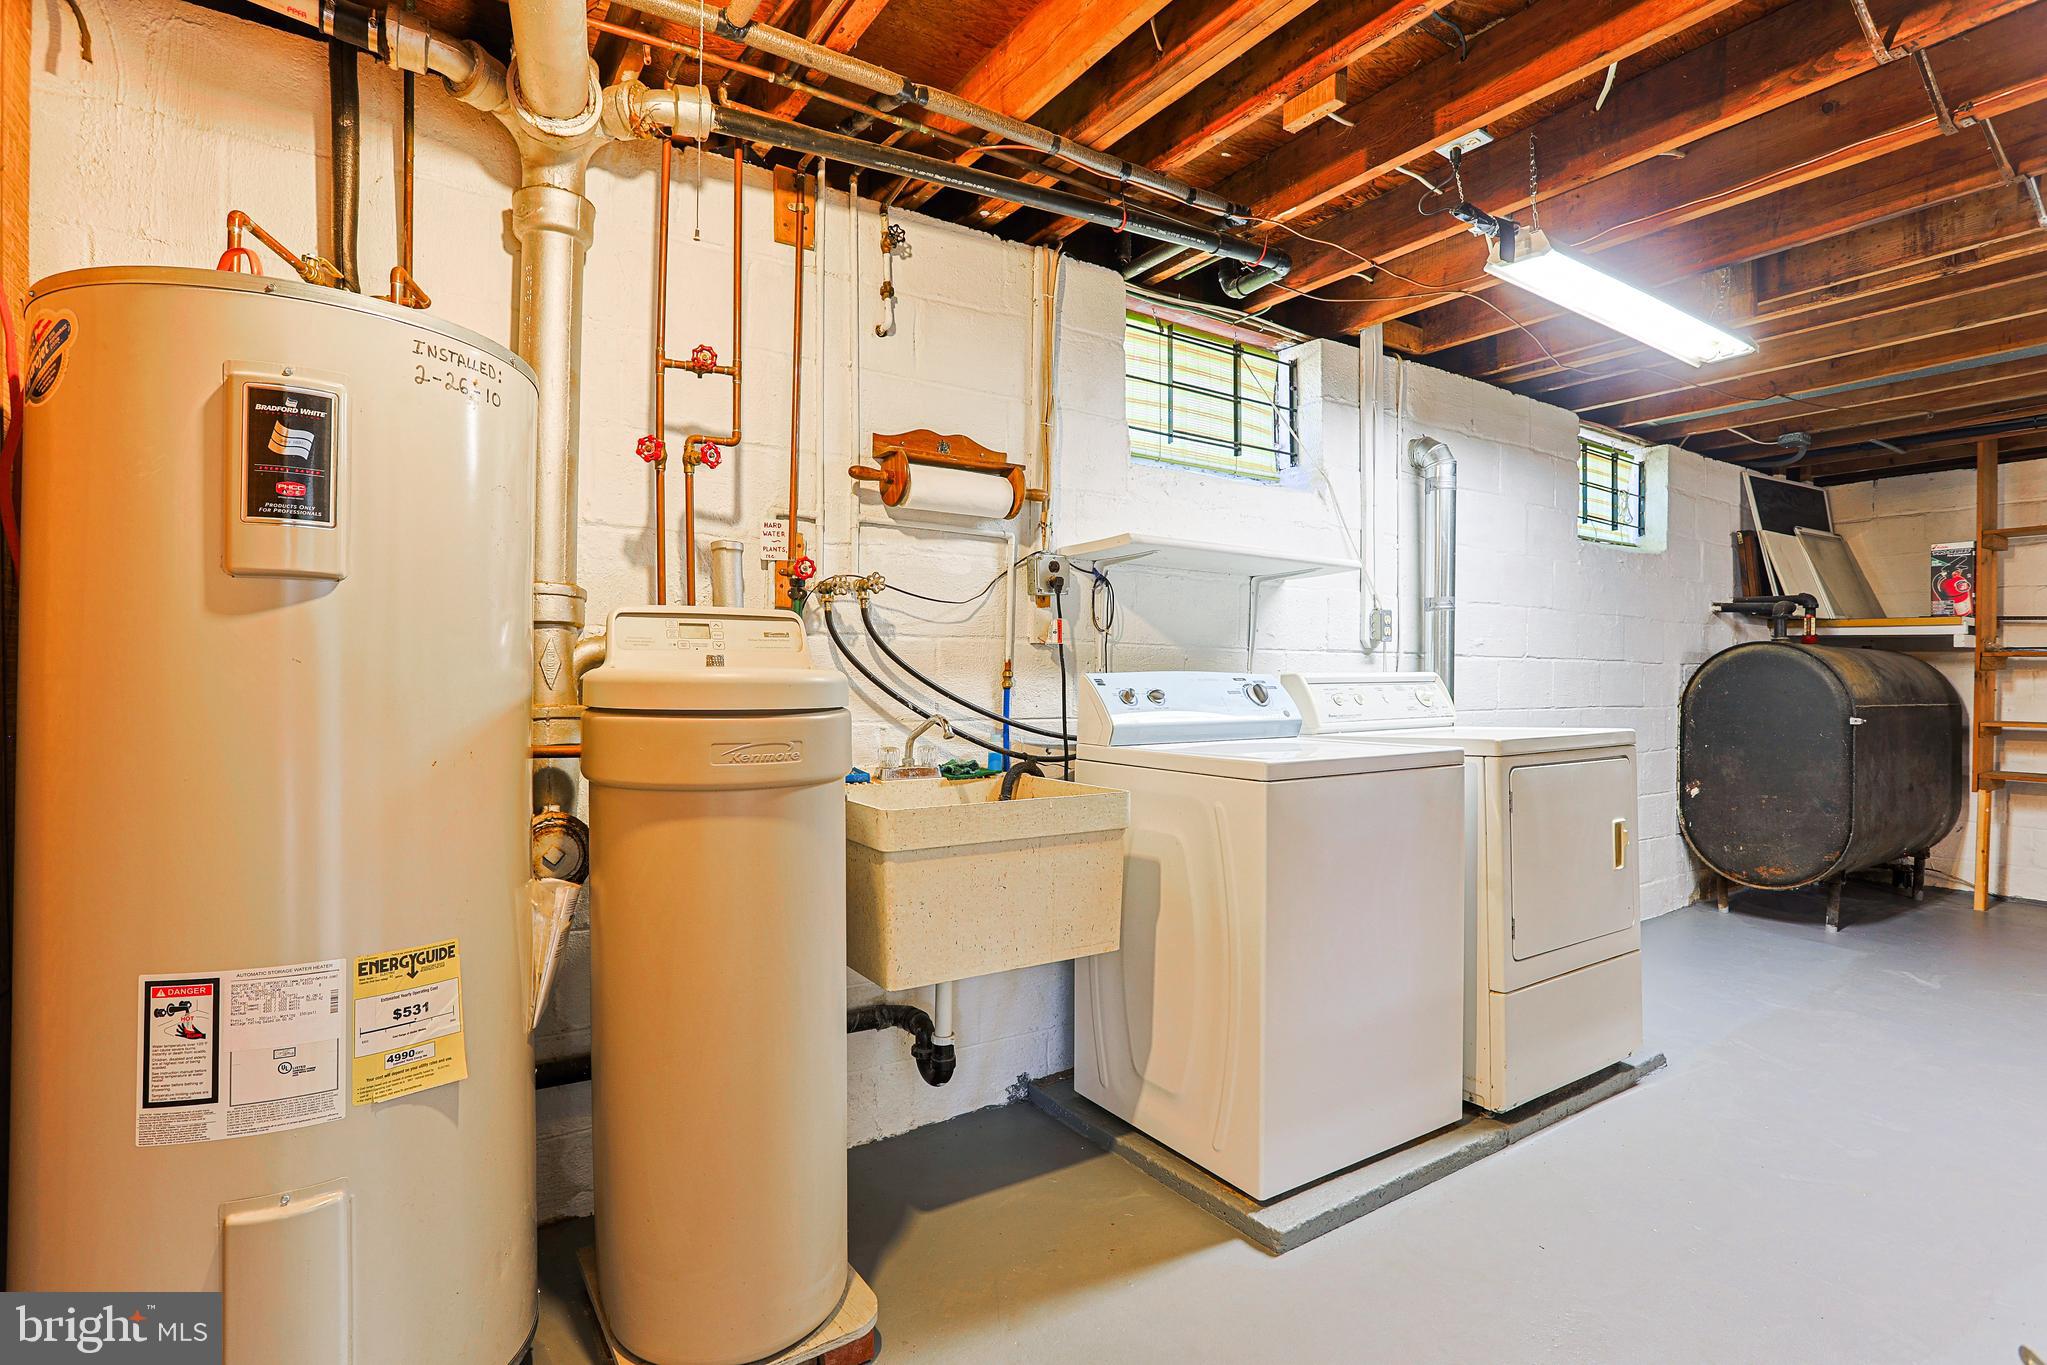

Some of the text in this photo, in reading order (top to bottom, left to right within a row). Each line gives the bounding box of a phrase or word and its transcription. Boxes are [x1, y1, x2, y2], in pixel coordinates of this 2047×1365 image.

[412, 339, 502, 384] INSTALLED:
[255, 403, 298, 414] BRADFORD
[300, 408, 326, 418] WHITE
[273, 508, 322, 517] PROFESSIONALS
[728, 750, 801, 764] Kenmore
[358, 945, 455, 978] ENERGYGUIDE
[167, 987, 206, 996] DANGER
[392, 1001, 429, 1021] $531
[386, 1049, 415, 1063] 4990
